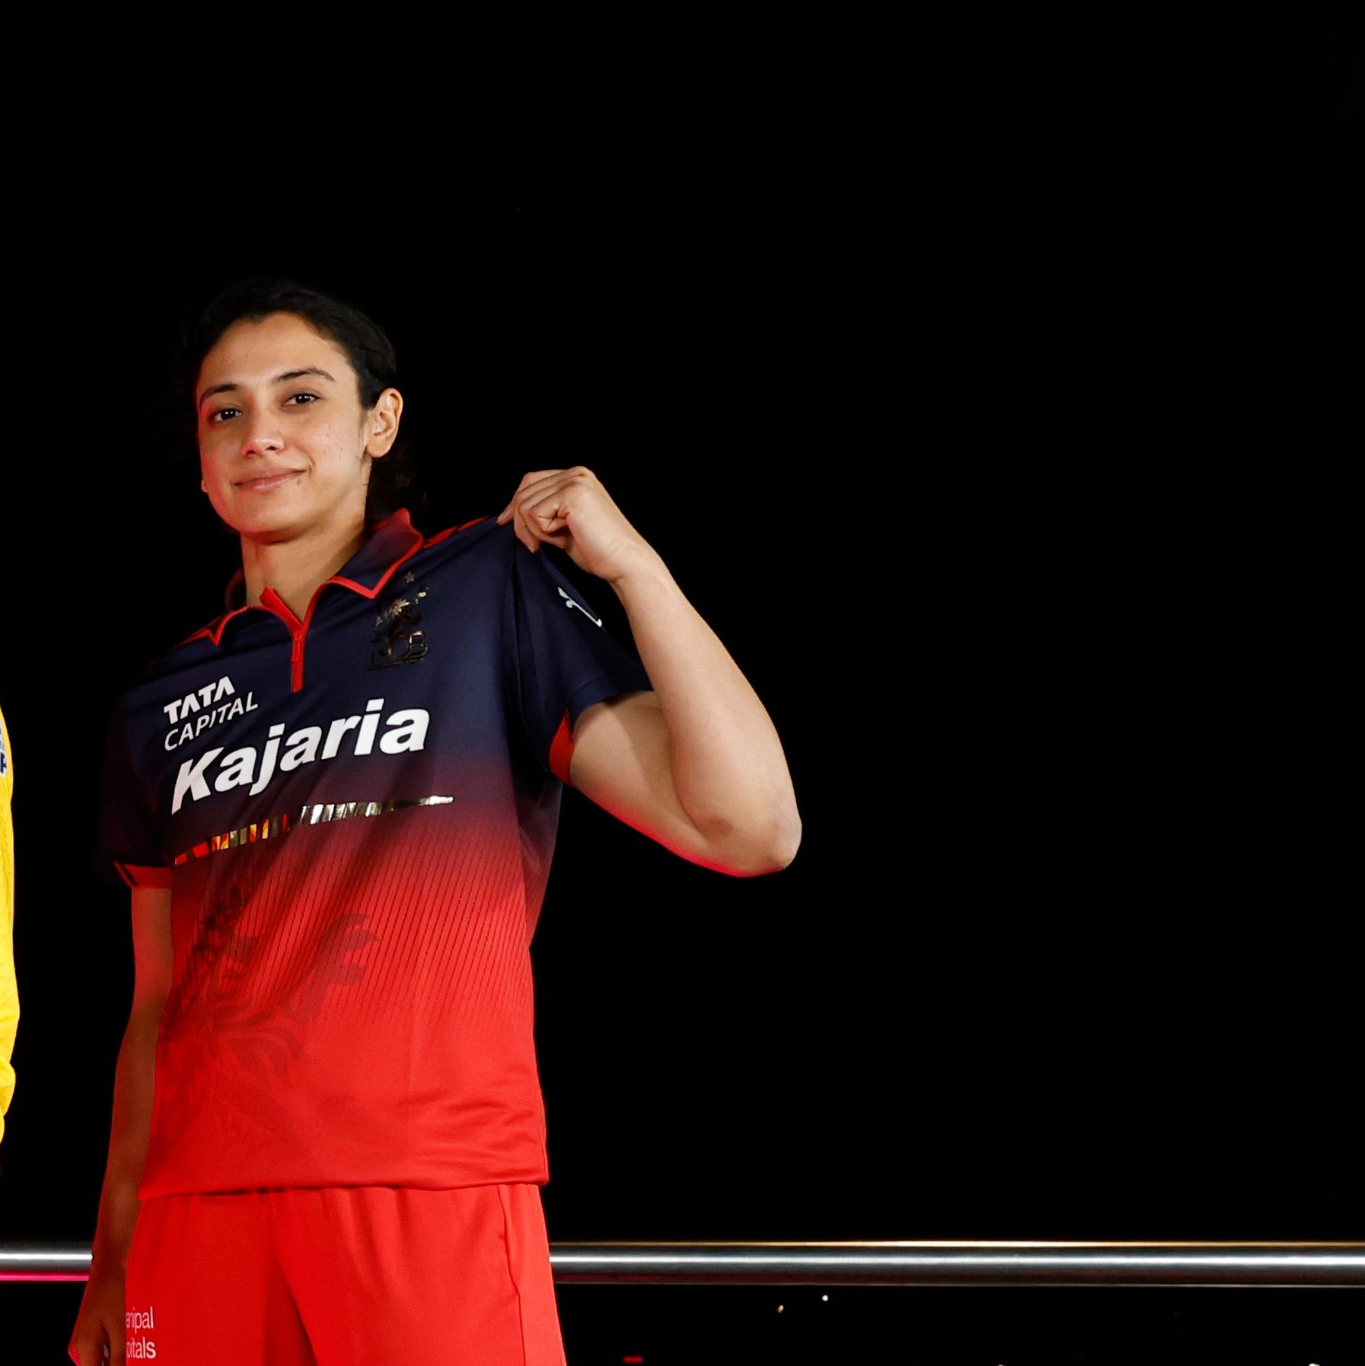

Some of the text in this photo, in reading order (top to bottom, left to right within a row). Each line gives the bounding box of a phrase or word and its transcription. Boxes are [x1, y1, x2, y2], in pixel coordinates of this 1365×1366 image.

[162, 675, 236, 725] TATA
[163, 691, 259, 752] CAPITAL
[170, 697, 431, 816] Kajaria
